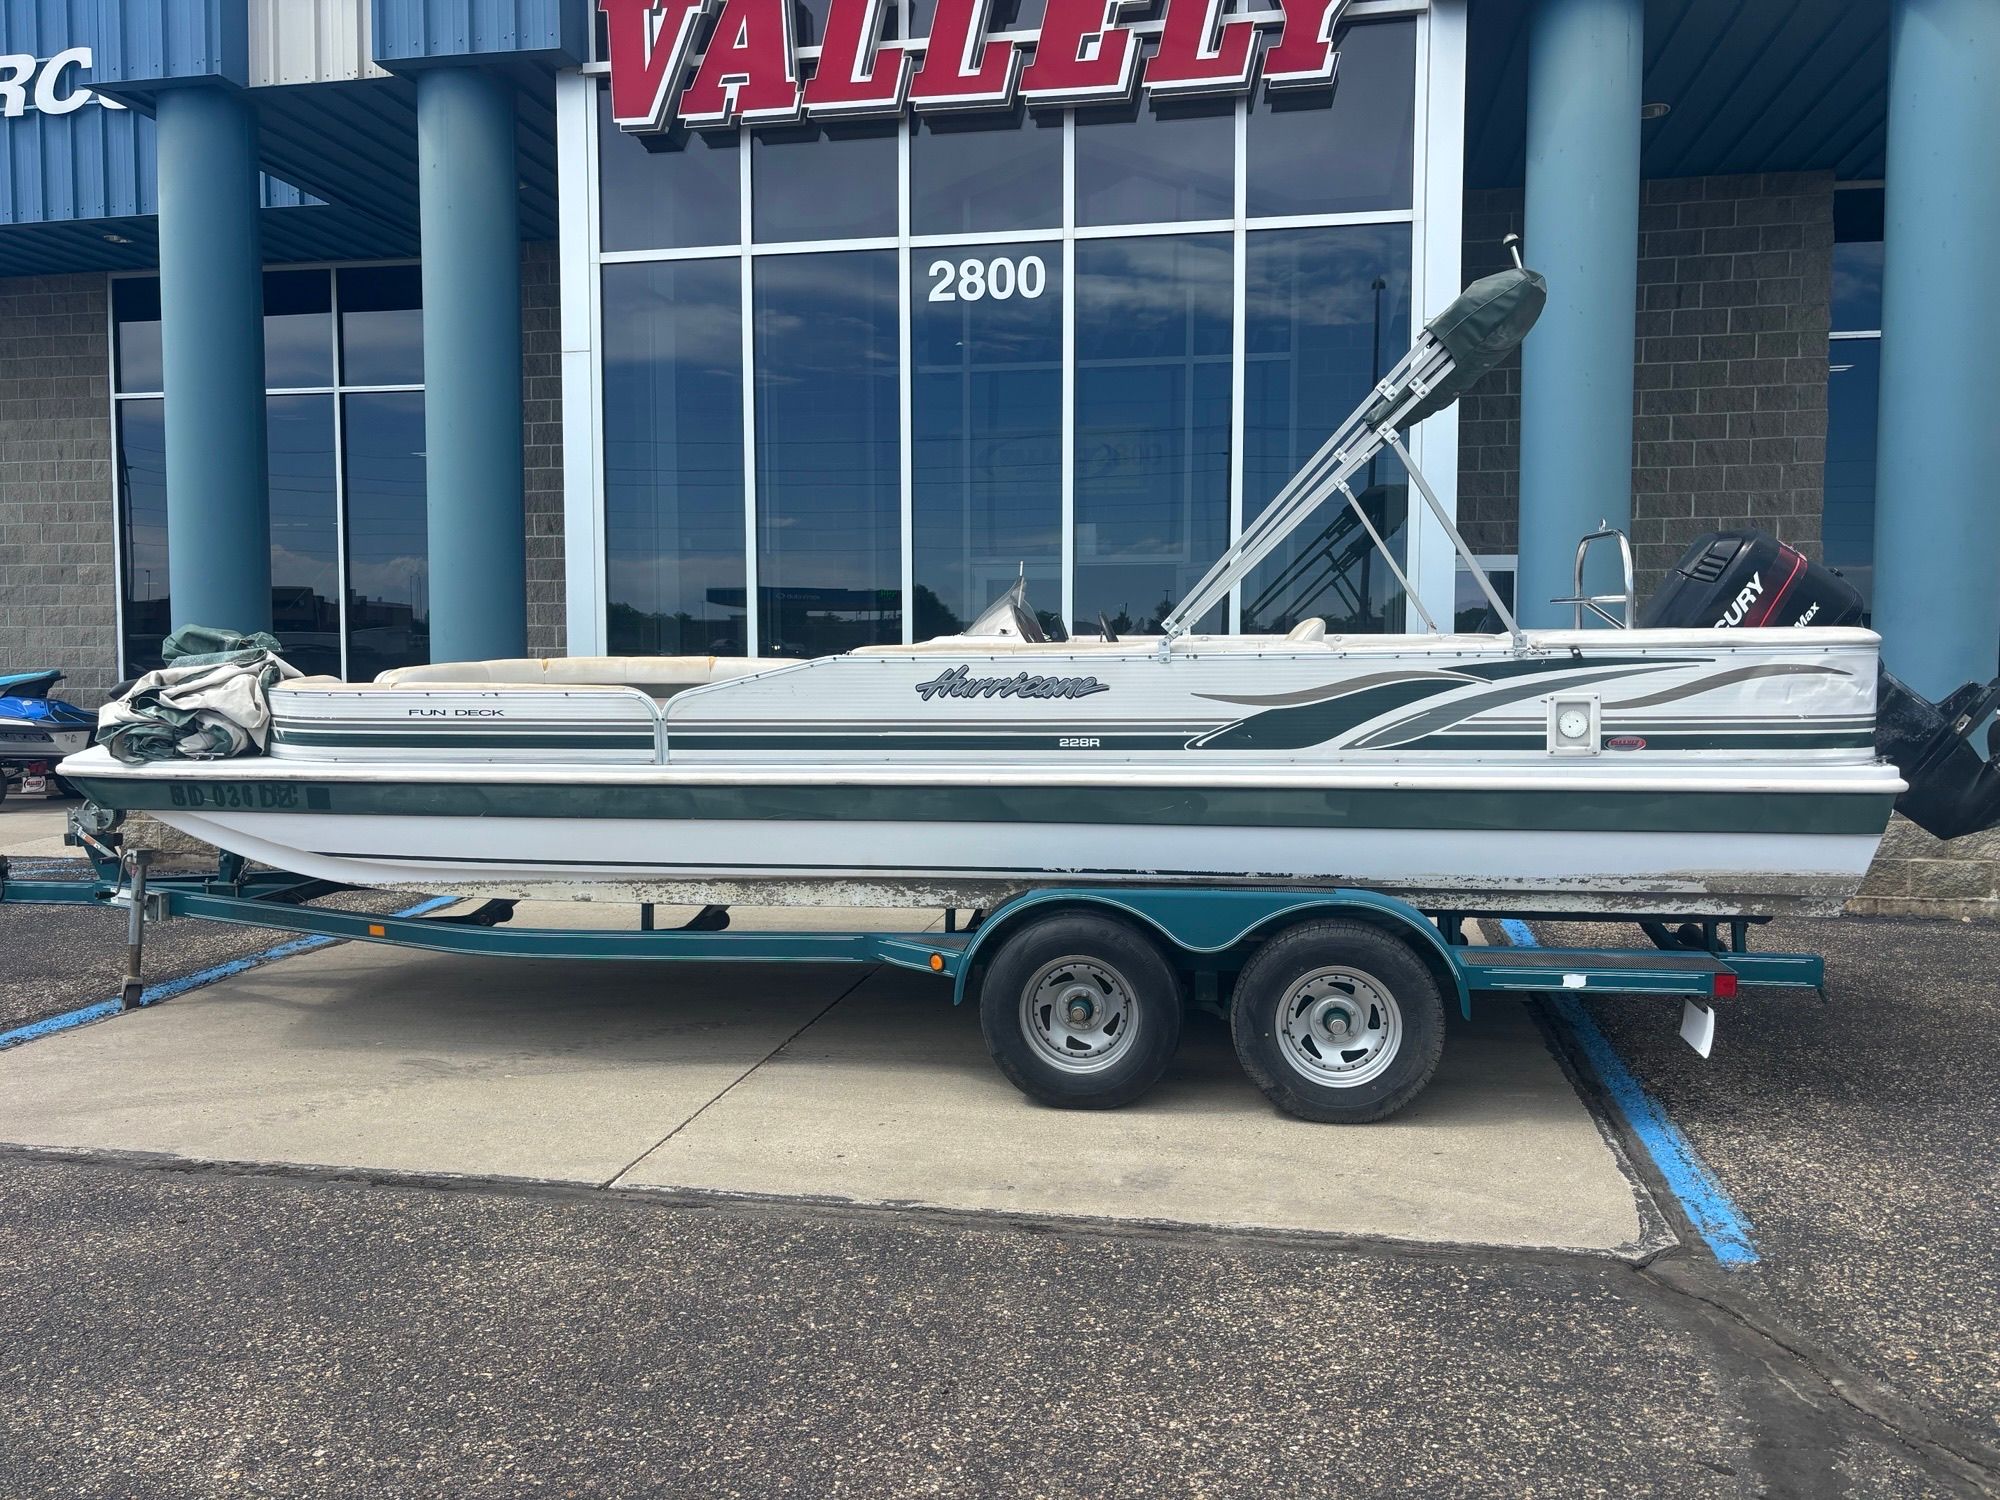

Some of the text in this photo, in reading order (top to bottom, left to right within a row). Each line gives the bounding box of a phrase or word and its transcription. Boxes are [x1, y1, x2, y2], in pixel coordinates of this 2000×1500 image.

[0, 47, 127, 116] RC
[598, 0, 1350, 132] VALLELY
[928, 255, 1046, 302] 2800
[915, 664, 1110, 701] Hurricane
[454, 709, 505, 717] DECK
[1059, 738, 1100, 747] 228R
